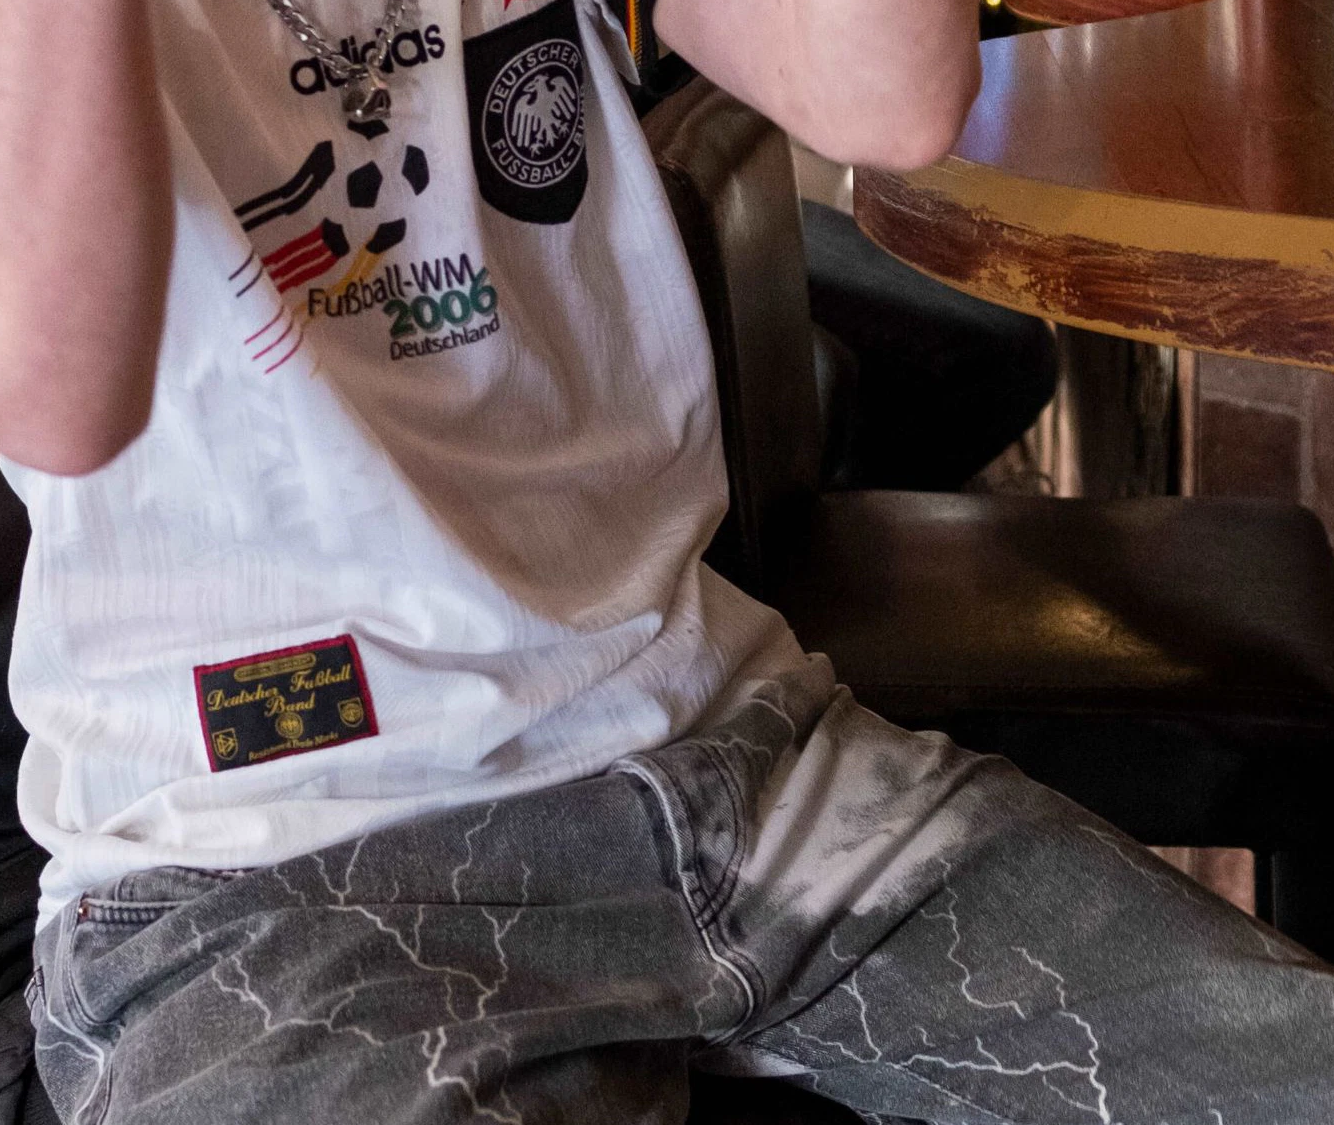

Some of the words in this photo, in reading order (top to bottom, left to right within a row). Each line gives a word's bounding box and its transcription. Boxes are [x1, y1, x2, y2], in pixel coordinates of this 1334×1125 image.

[489, 44, 579, 115] DEUTSCHER
[307, 253, 475, 318] Fußball-WM
[383, 267, 498, 339] 2006
[390, 312, 500, 361] Deutschland
